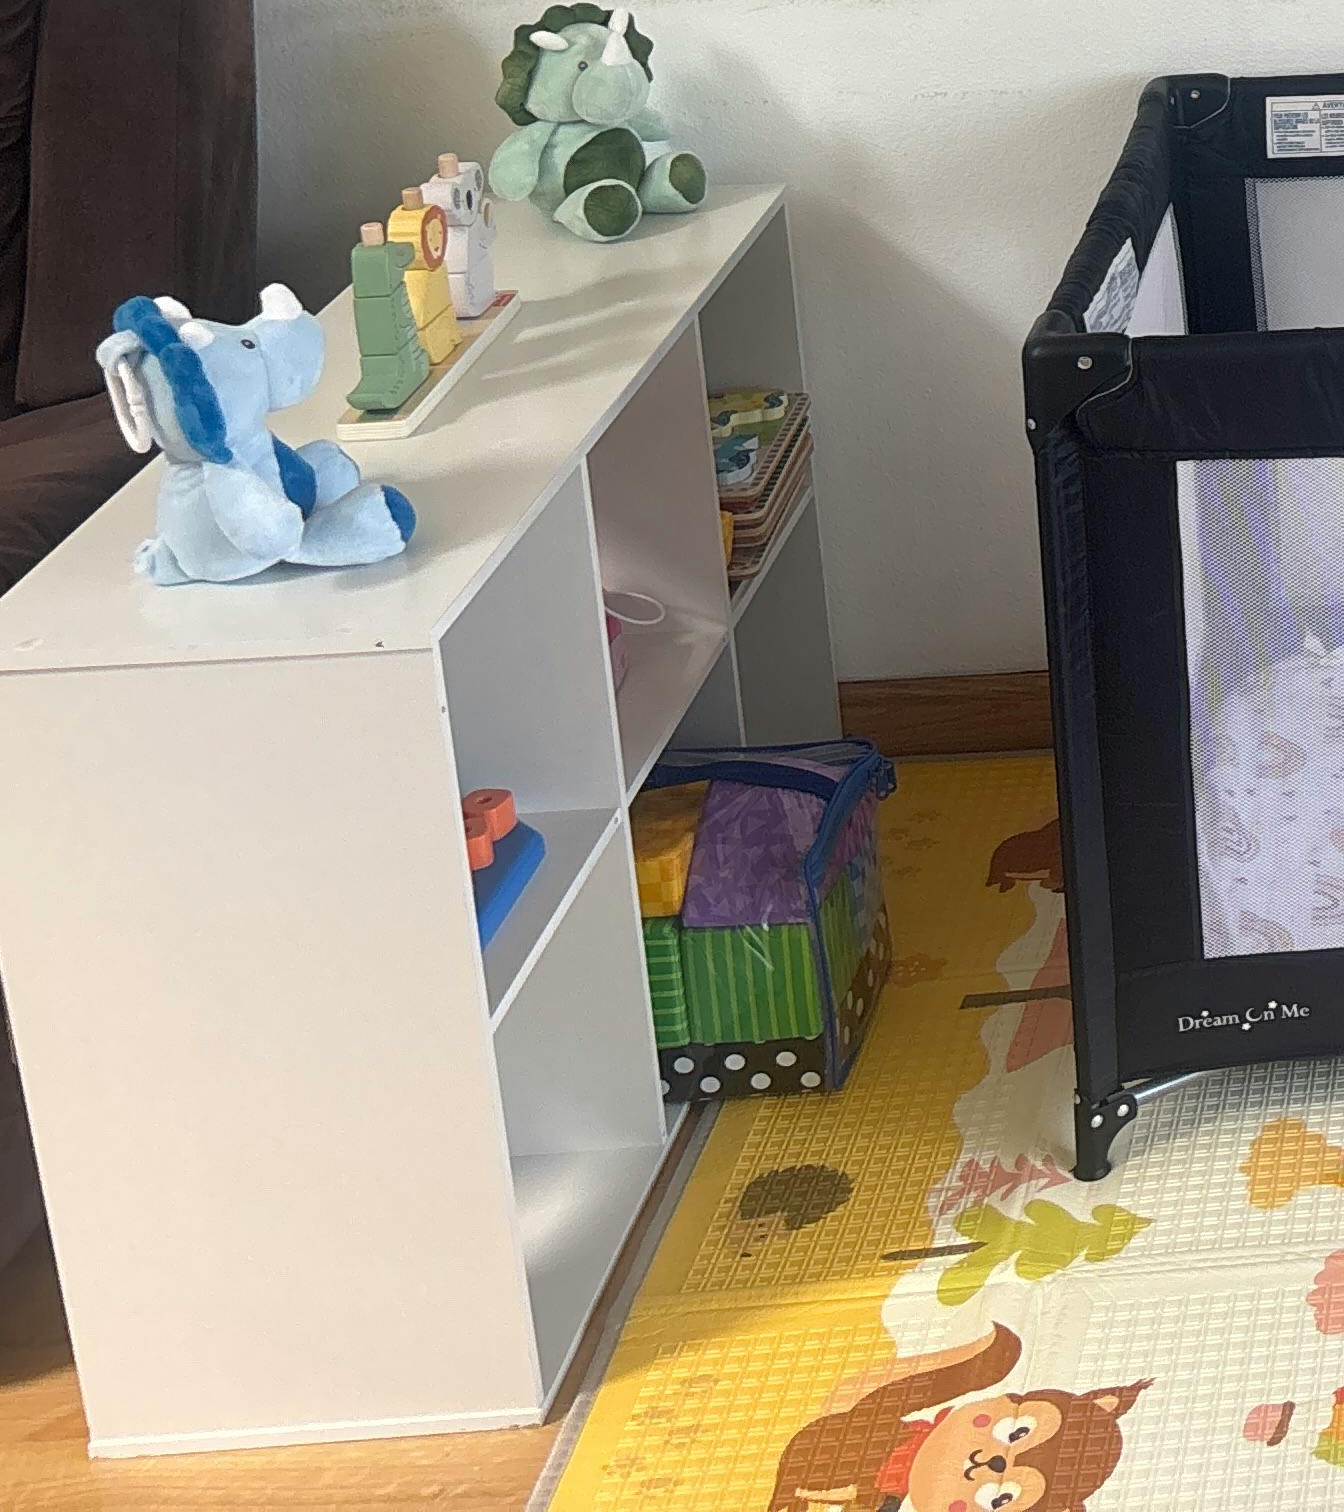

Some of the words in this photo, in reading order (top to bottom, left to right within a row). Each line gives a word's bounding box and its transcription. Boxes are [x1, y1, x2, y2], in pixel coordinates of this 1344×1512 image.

[1178, 1013, 1240, 1032] Dream
[1245, 1006, 1275, 1023] On
[1281, 1003, 1311, 1020] Me
